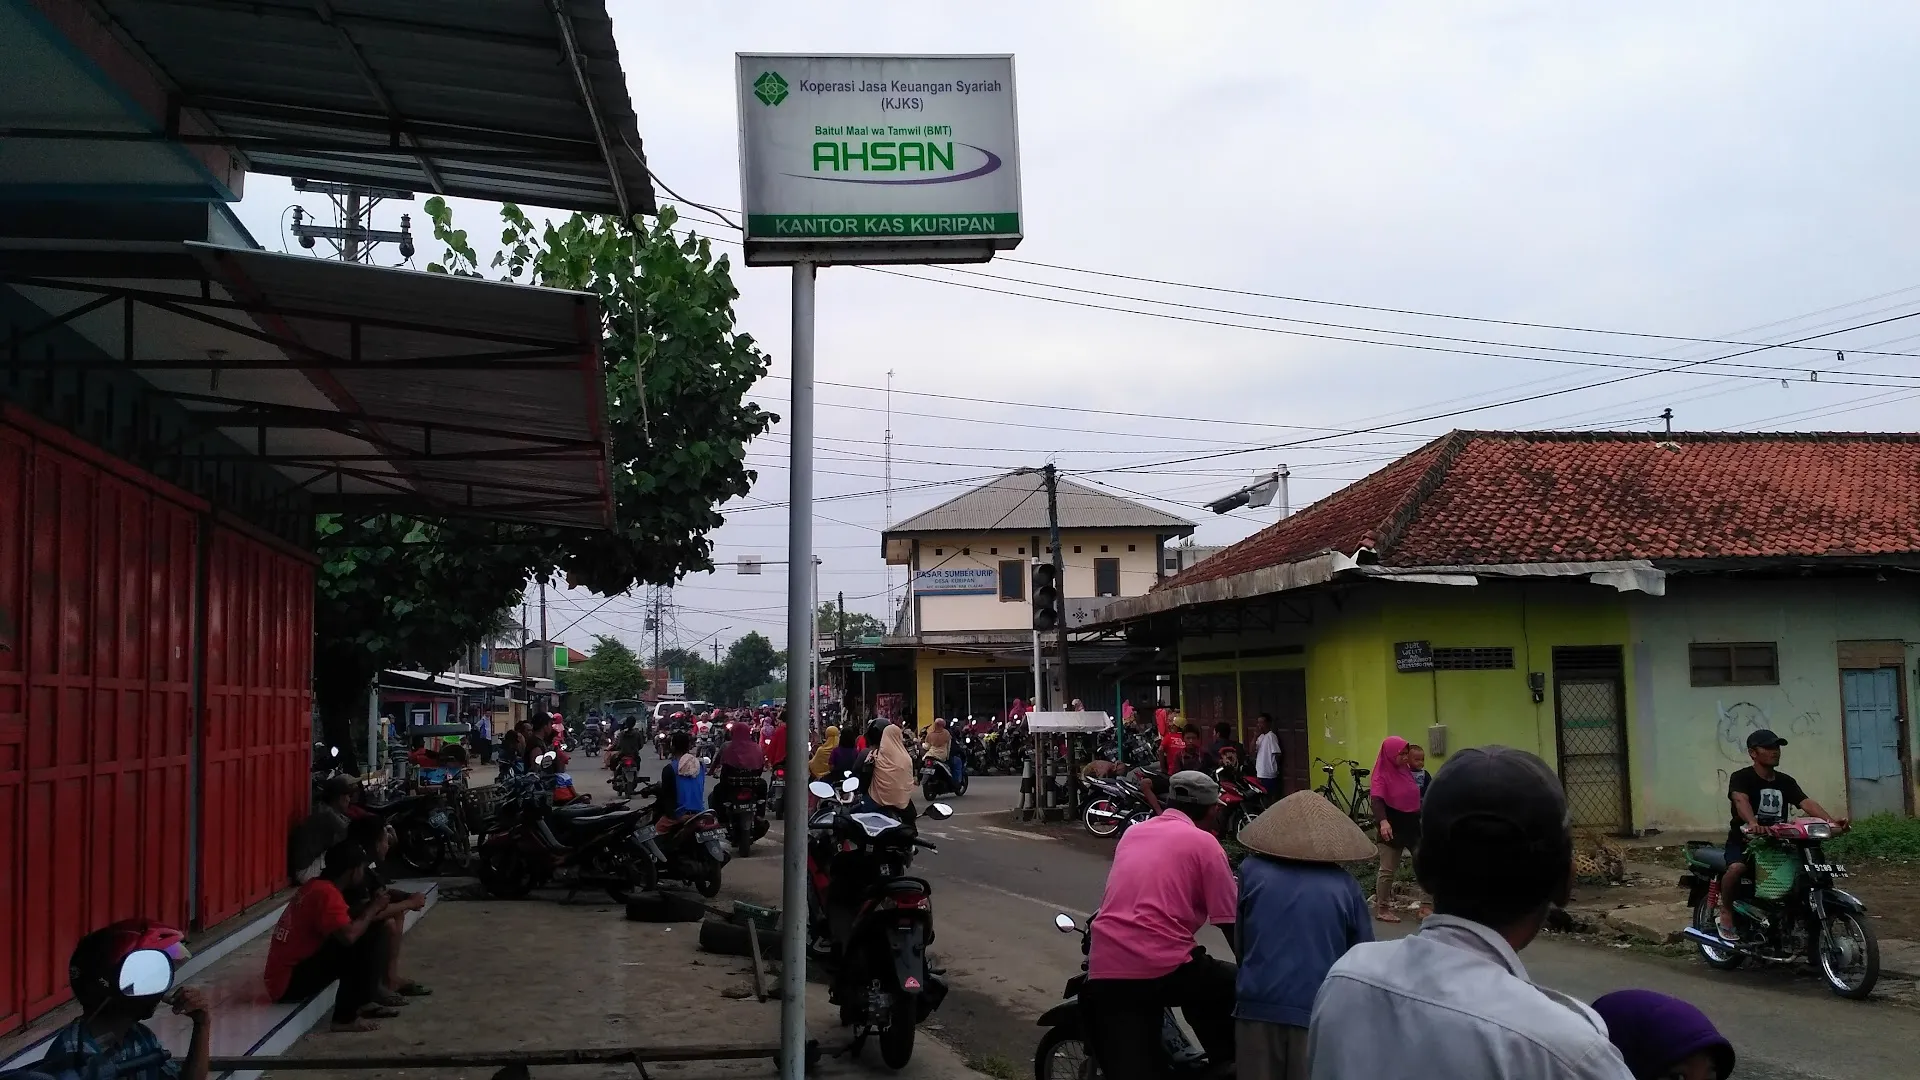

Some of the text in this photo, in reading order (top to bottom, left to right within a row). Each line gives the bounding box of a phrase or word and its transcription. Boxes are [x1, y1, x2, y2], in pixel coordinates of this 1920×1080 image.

[799, 79, 1002, 96] Koperasi Jasa Keuangan Syariah
[881, 97, 924, 112] (KJKS)
[814, 125, 952, 137] Baitul Maal wa Tamwil (BMT)
[812, 141, 954, 171] AHSAN
[775, 216, 995, 234] KANTOR KAS KURIPAN
[916, 569, 993, 578] PASAR SUMBER URIP
[1804, 864, 1812, 872] R
